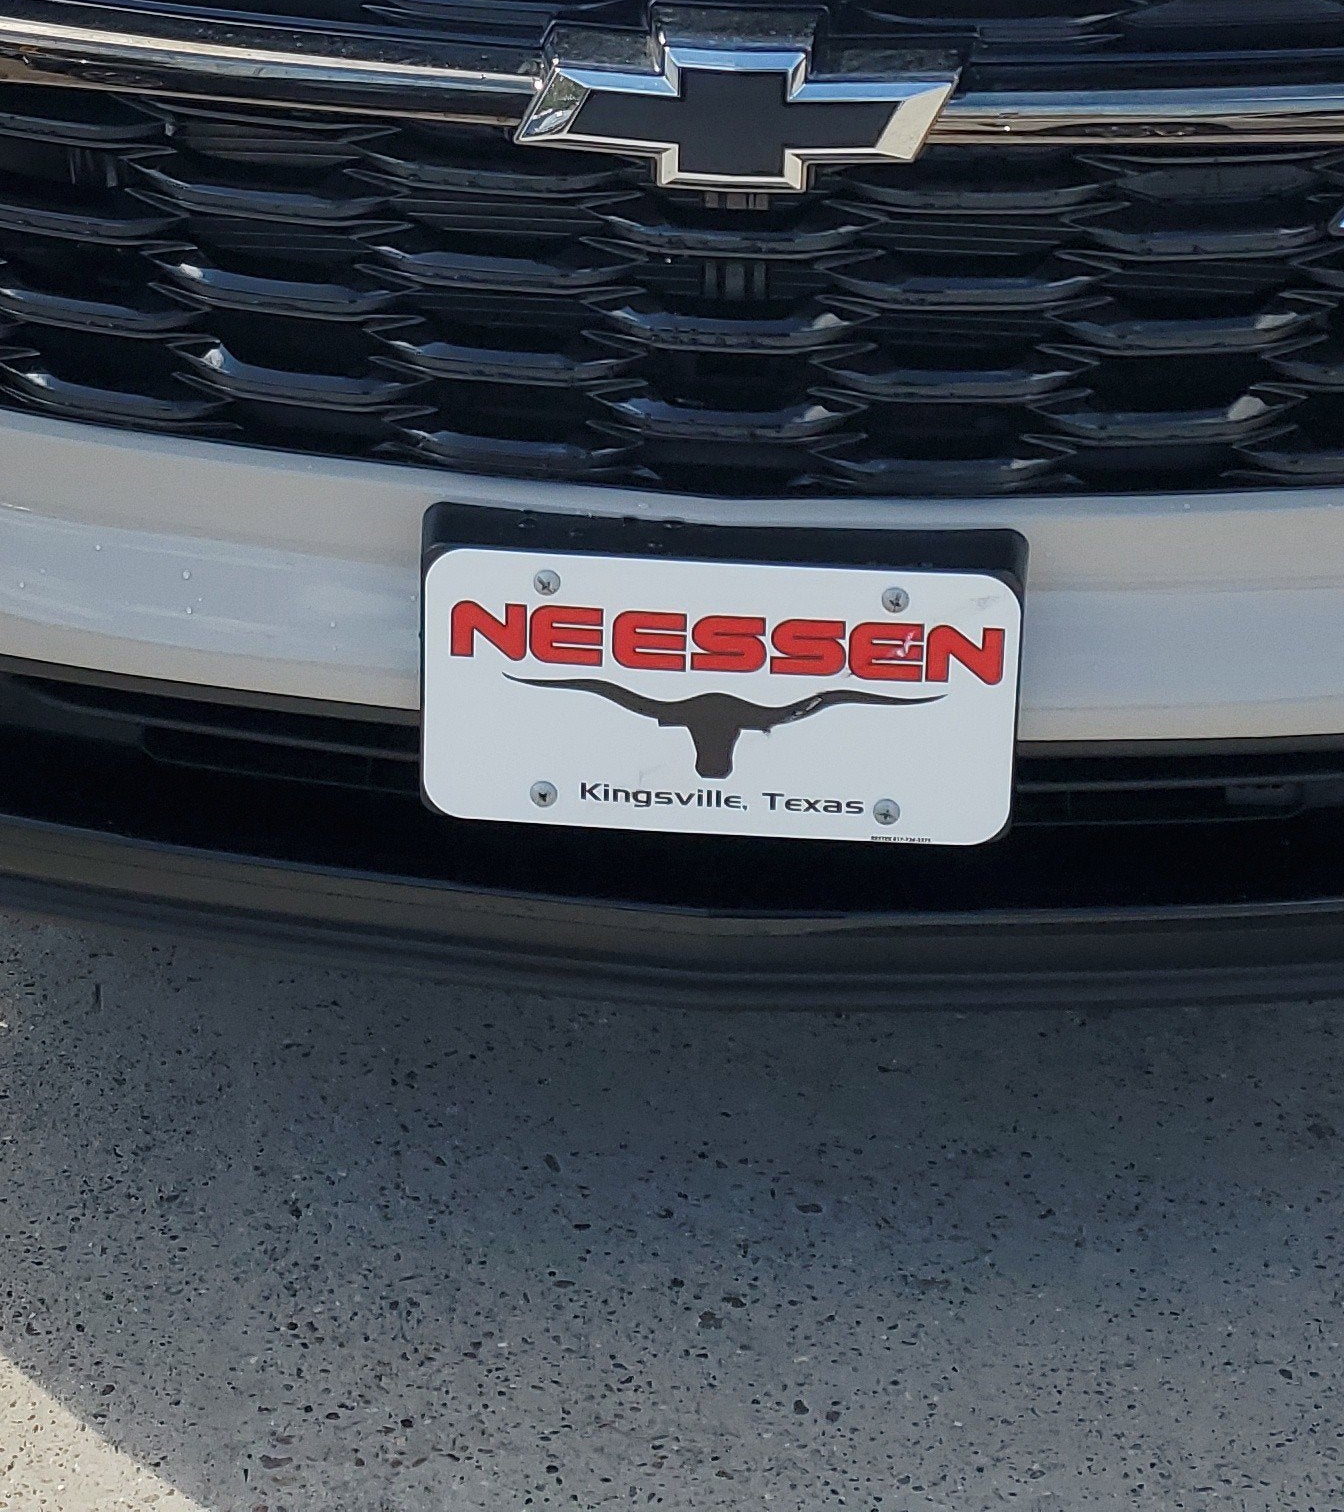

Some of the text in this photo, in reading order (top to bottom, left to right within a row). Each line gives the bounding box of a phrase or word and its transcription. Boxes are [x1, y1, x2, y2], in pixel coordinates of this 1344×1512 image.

[450, 599, 1006, 686] NEESSEN
[580, 782, 864, 814] Kingsville, Texas
